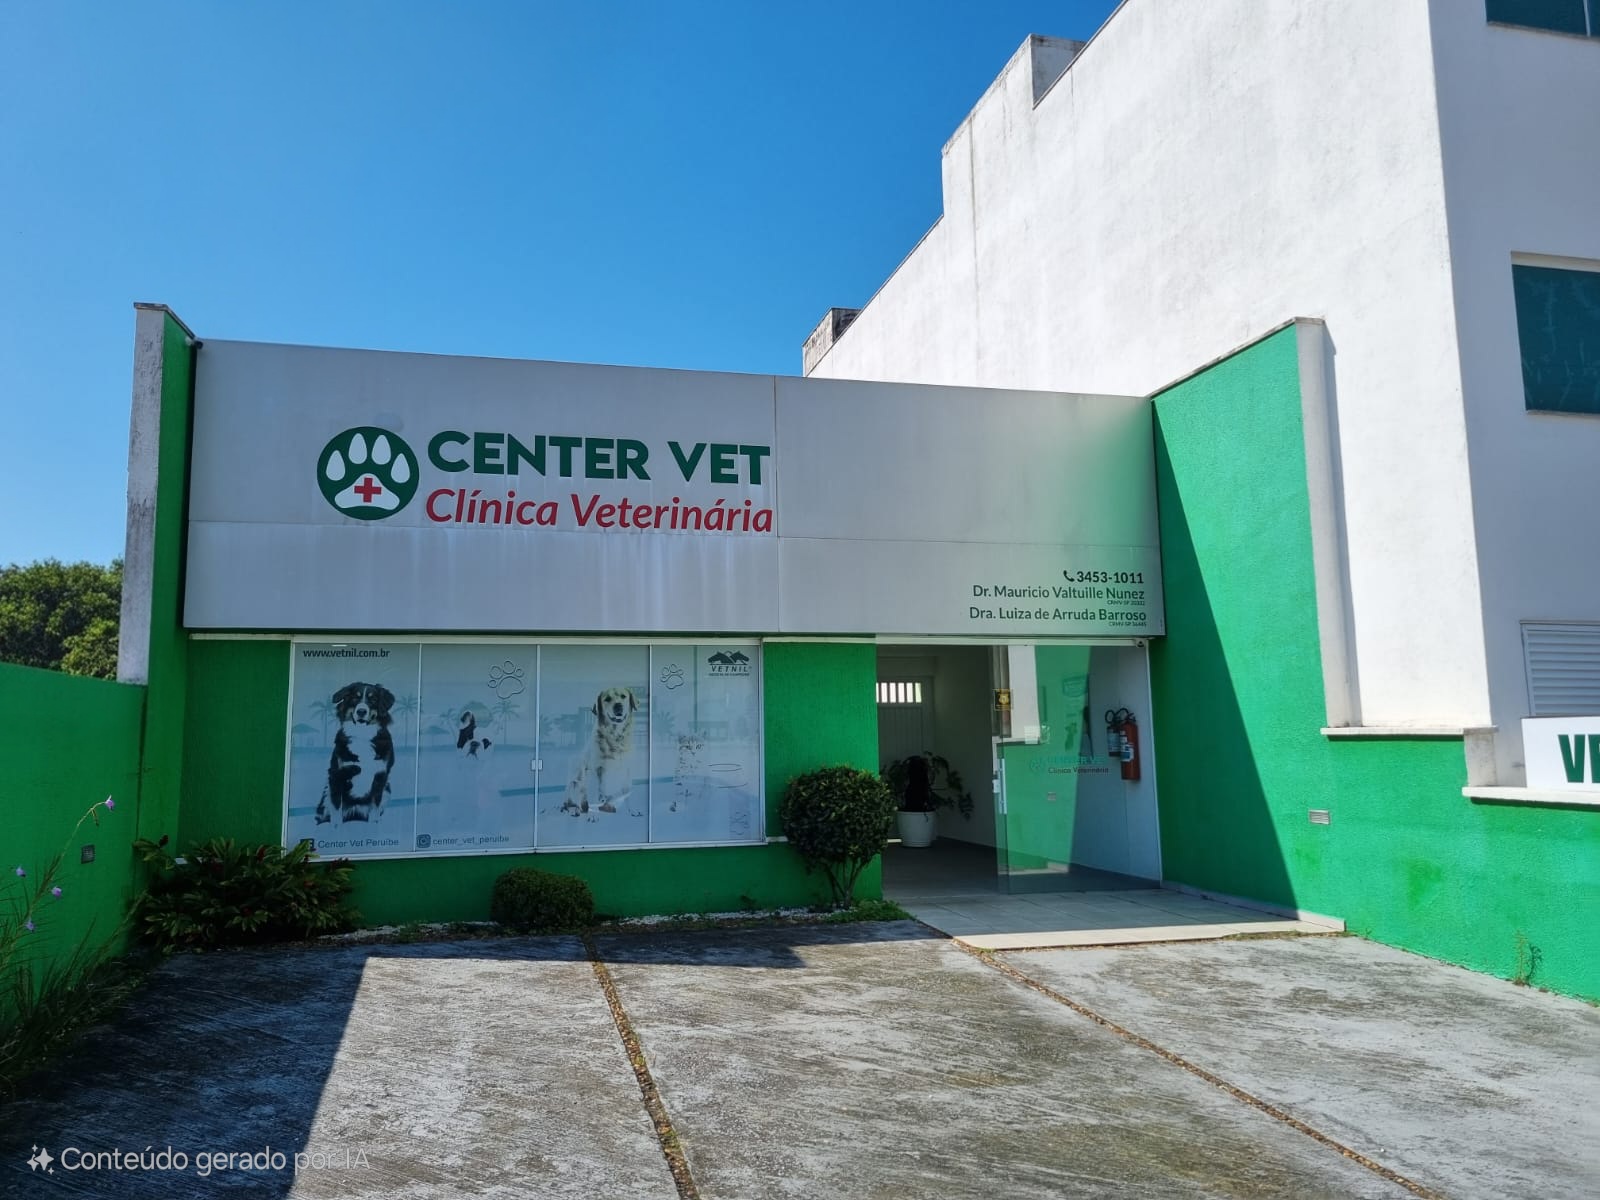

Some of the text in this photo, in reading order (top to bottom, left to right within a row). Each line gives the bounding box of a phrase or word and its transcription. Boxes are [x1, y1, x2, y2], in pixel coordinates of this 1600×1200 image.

[427, 430, 772, 485] CENTER VET
[425, 488, 773, 532] Clínica Veterinária
[1076, 571, 1144, 583] 3453-1011
[972, 585, 1145, 600] Dr. Mauricio Valtuille Nunez
[969, 607, 1147, 621] Dra. Luiza de Arruda Barroso
[303, 648, 391, 658] www.vetnil.com.br
[317, 839, 347, 849] Center
[349, 839, 364, 848] Vet
